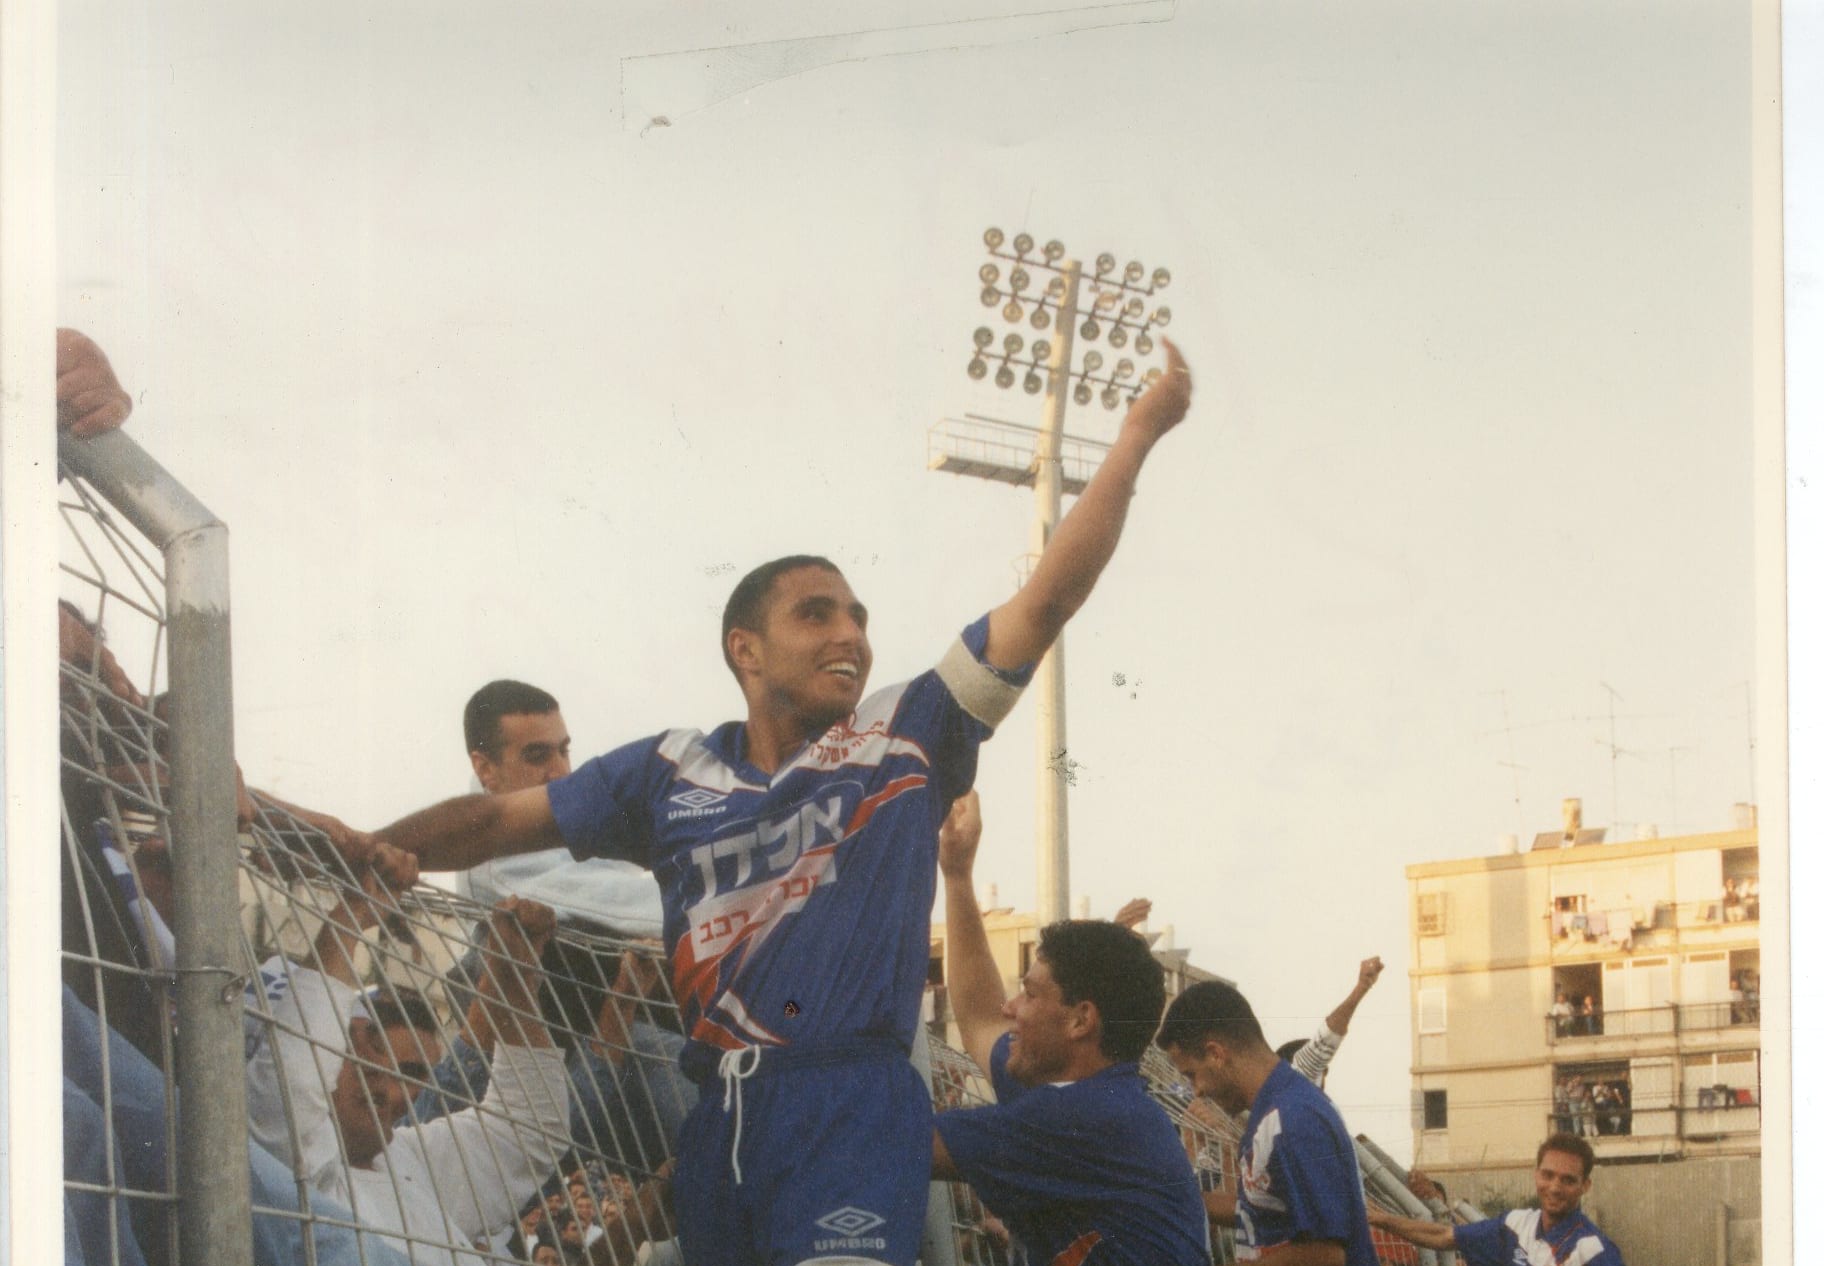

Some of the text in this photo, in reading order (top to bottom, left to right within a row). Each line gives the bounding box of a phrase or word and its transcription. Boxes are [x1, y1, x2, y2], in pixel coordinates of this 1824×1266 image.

[691, 796, 845, 901] אלדן
[699, 910, 750, 944] רכב
[814, 1237, 886, 1251] UMBRO
